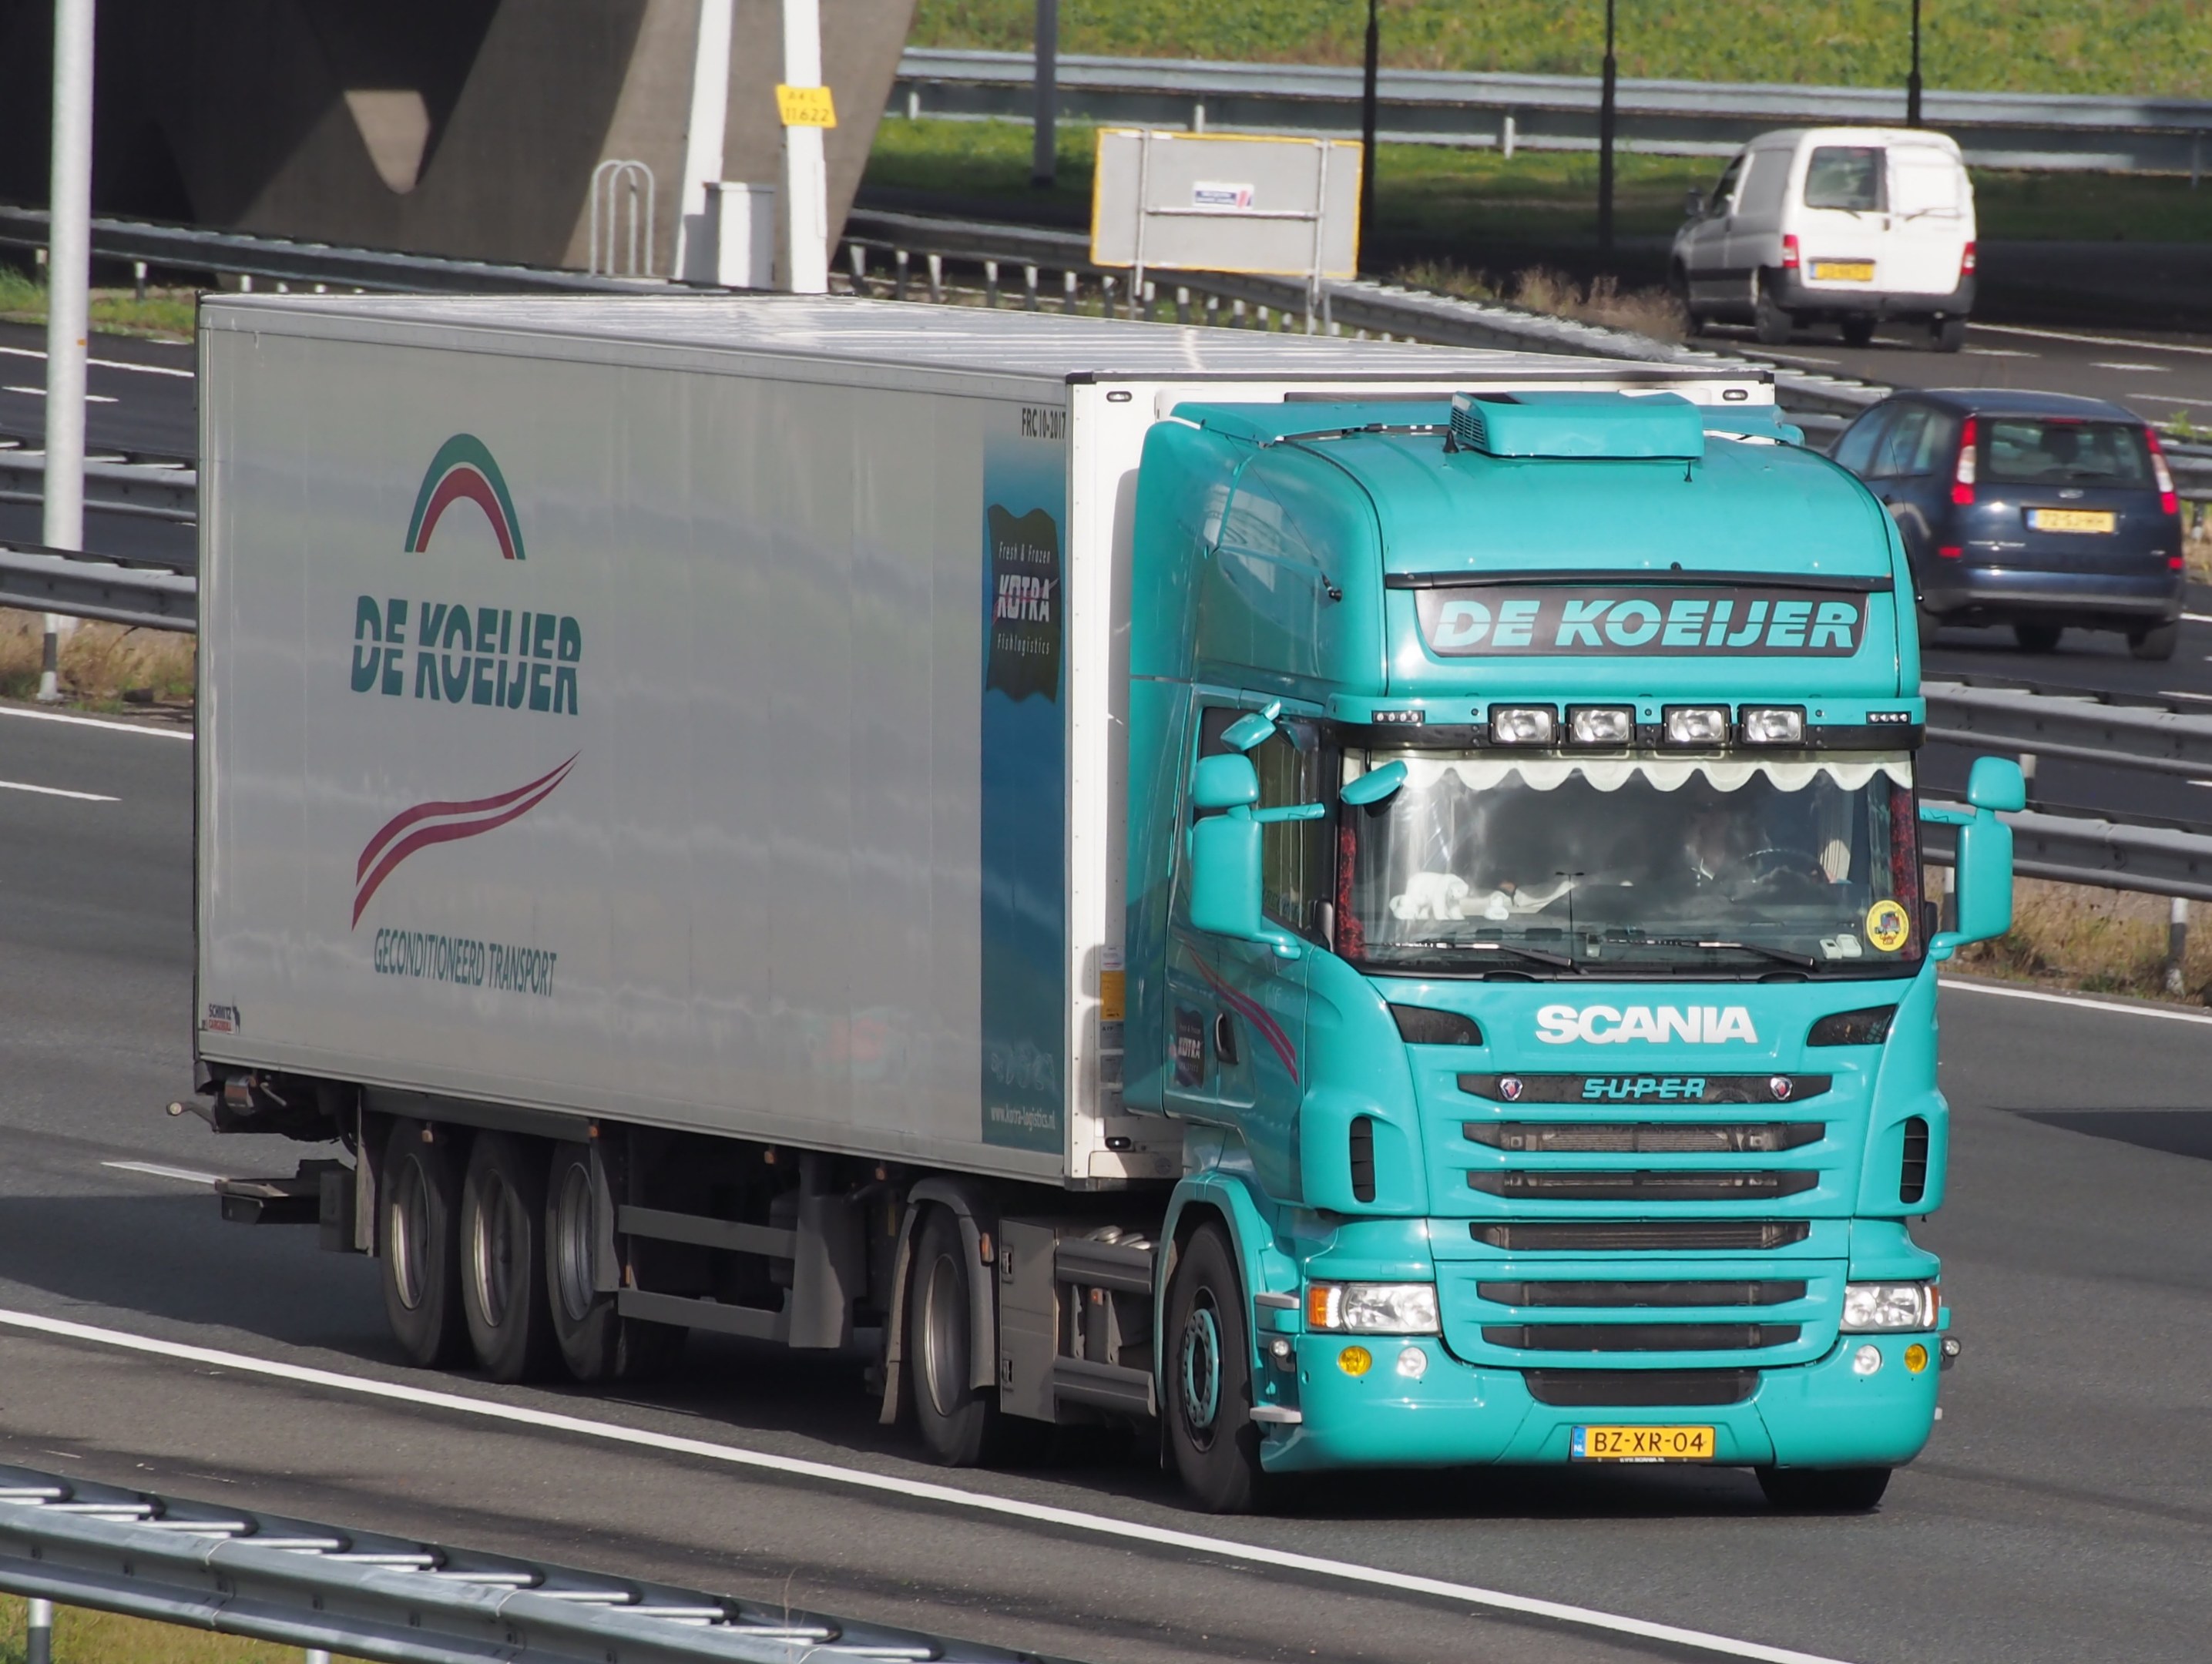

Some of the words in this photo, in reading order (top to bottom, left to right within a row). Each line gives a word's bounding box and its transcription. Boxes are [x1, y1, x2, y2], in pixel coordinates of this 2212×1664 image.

[1022, 408, 1038, 438] FRC
[1039, 409, 1066, 440] 10-2017
[999, 541, 1018, 561] Fresh
[1028, 544, 1050, 564] Frozen
[998, 575, 1049, 622] KOTRA
[1432, 600, 1541, 647] DE
[1555, 600, 1858, 648] KOEIJER
[351, 595, 408, 696] DE
[415, 602, 582, 716] KOEIJER
[998, 633, 1050, 656] Fishlogistics
[374, 928, 485, 986] GECONDITIONEERD
[488, 942, 557, 997] TRANSPORT
[1535, 1005, 1758, 1044] SCANIA
[1582, 1079, 1706, 1099] SUPER
[1594, 1432, 1703, 1452] BZ-XR-04
